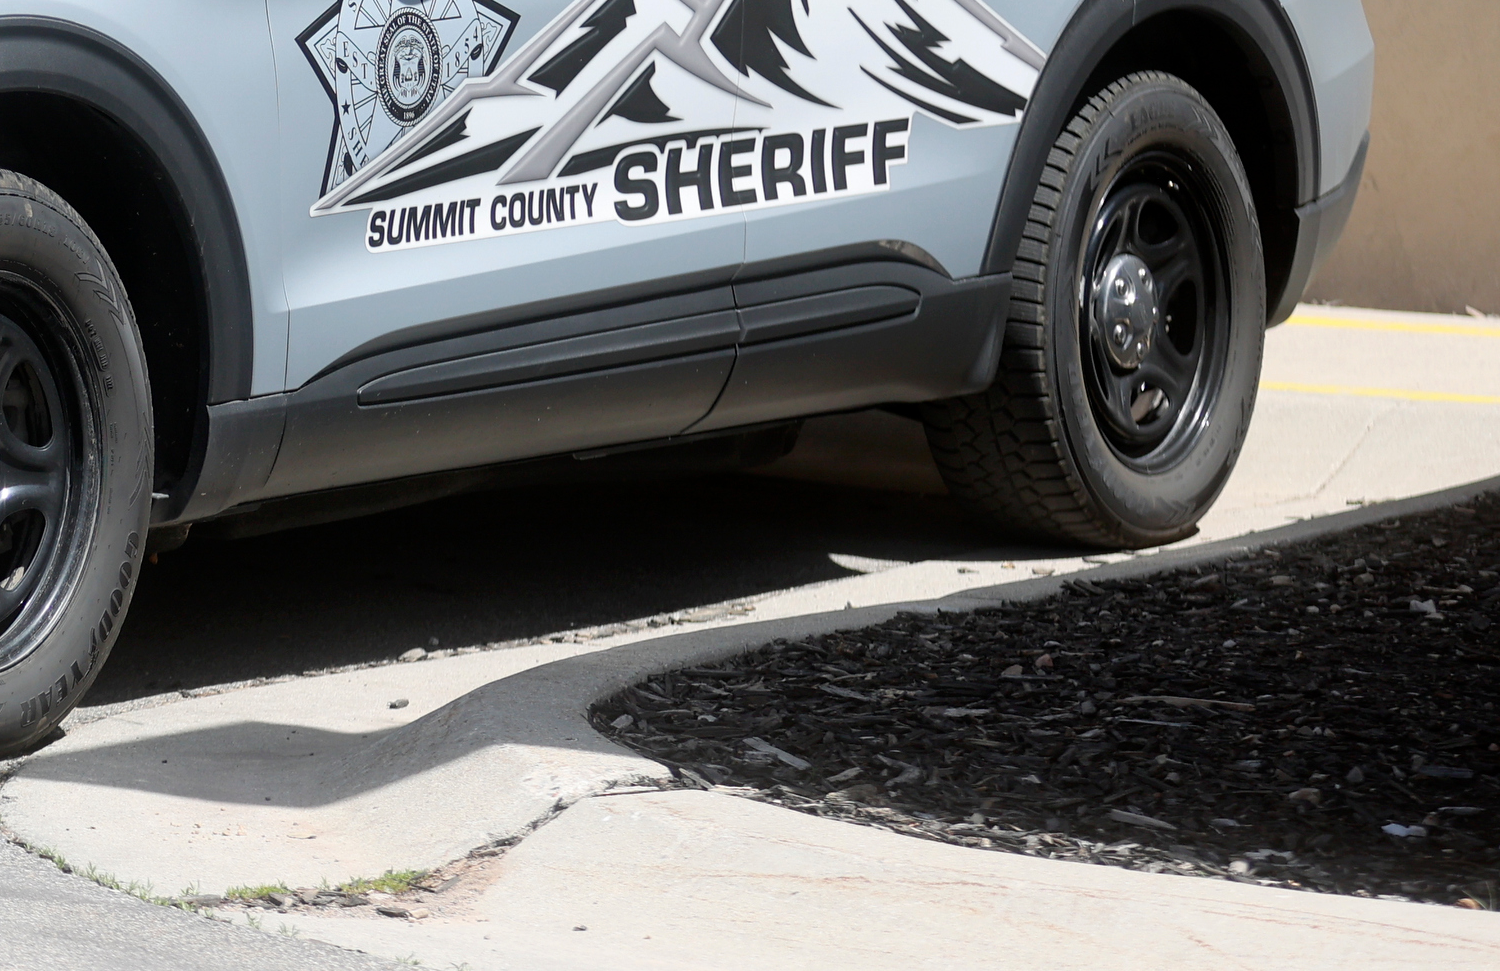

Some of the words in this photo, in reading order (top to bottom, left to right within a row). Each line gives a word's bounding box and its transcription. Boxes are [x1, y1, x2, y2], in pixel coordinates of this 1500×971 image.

[383, 21, 399, 46] SEAL
[397, 15, 407, 27] OF
[407, 14, 422, 26] THE
[446, 25, 479, 78] 1854
[343, 40, 373, 85] EST.
[367, 196, 481, 248] SUMMIT
[490, 182, 599, 231] COUNTY
[613, 117, 910, 222] SHERIFF
